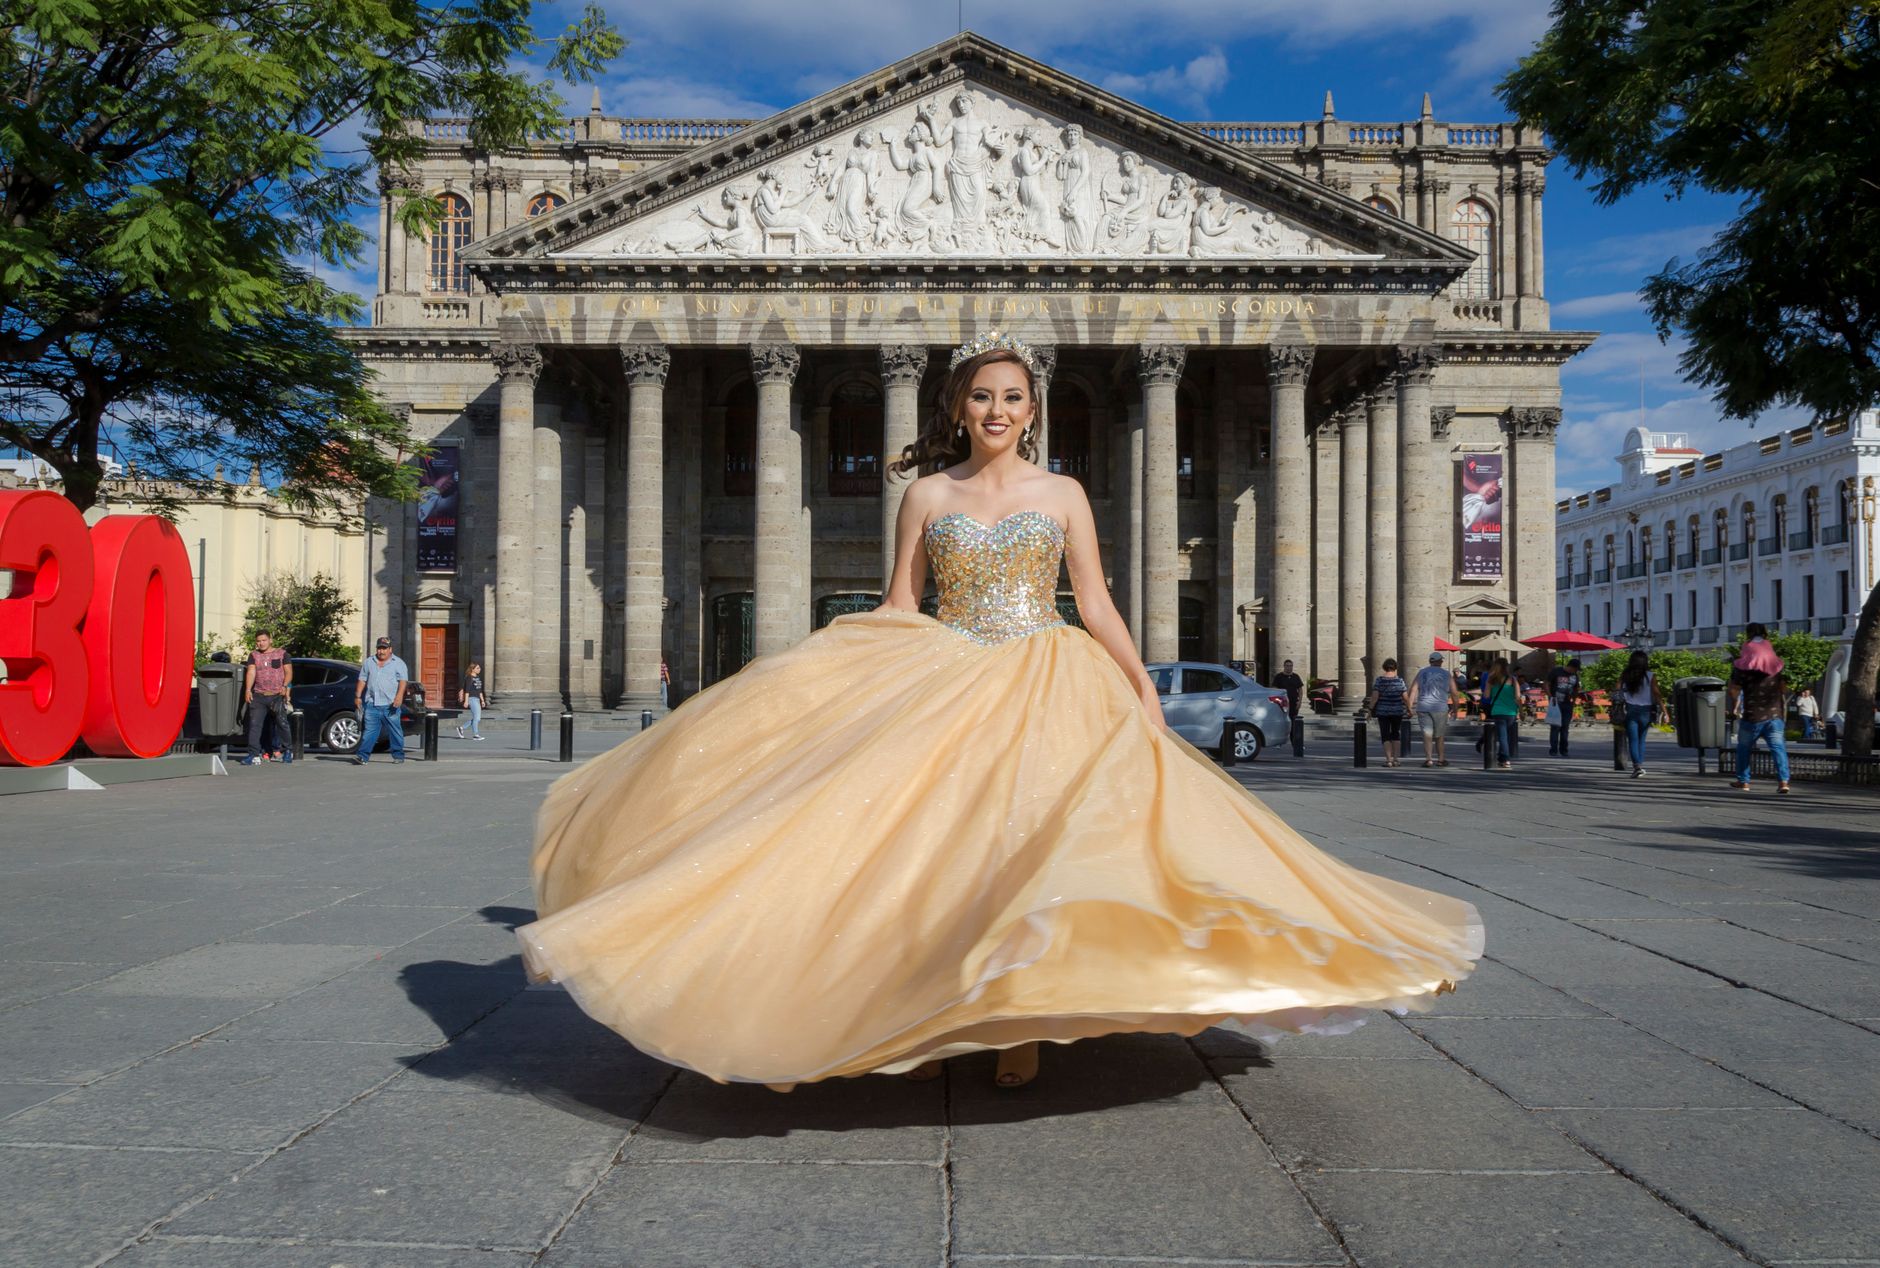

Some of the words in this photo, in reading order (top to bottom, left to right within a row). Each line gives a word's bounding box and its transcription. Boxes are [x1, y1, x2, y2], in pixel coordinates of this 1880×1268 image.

[696, 299, 774, 313] NUNCA
[973, 299, 1050, 313] RUMOR
[1082, 300, 1106, 313] DE
[1192, 300, 1315, 314] DISCORDIA
